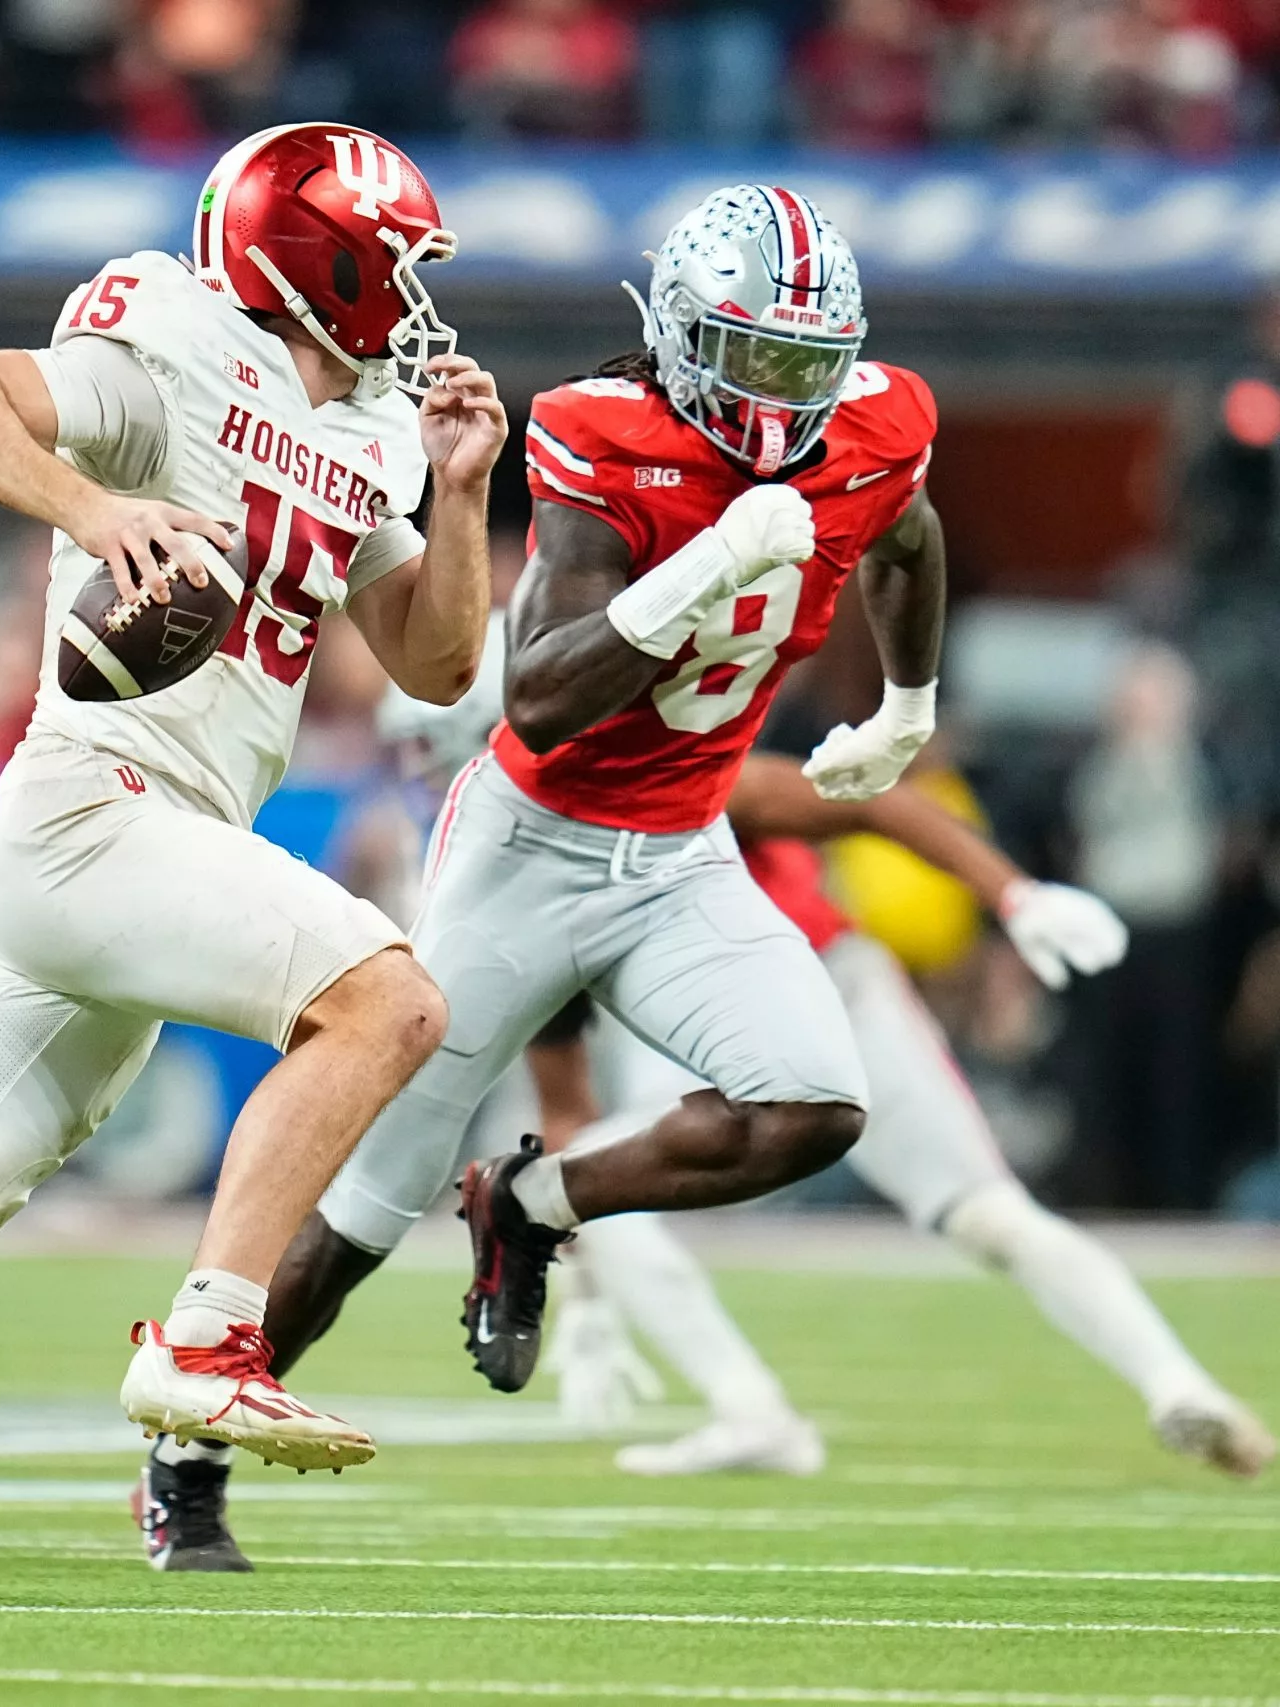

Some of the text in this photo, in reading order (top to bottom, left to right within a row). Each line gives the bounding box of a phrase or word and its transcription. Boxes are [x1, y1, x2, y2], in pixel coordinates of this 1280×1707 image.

[68, 275, 140, 330] 15
[217, 404, 389, 529] HOOSIERS
[218, 480, 360, 689] 15
[651, 563, 803, 734] 8
